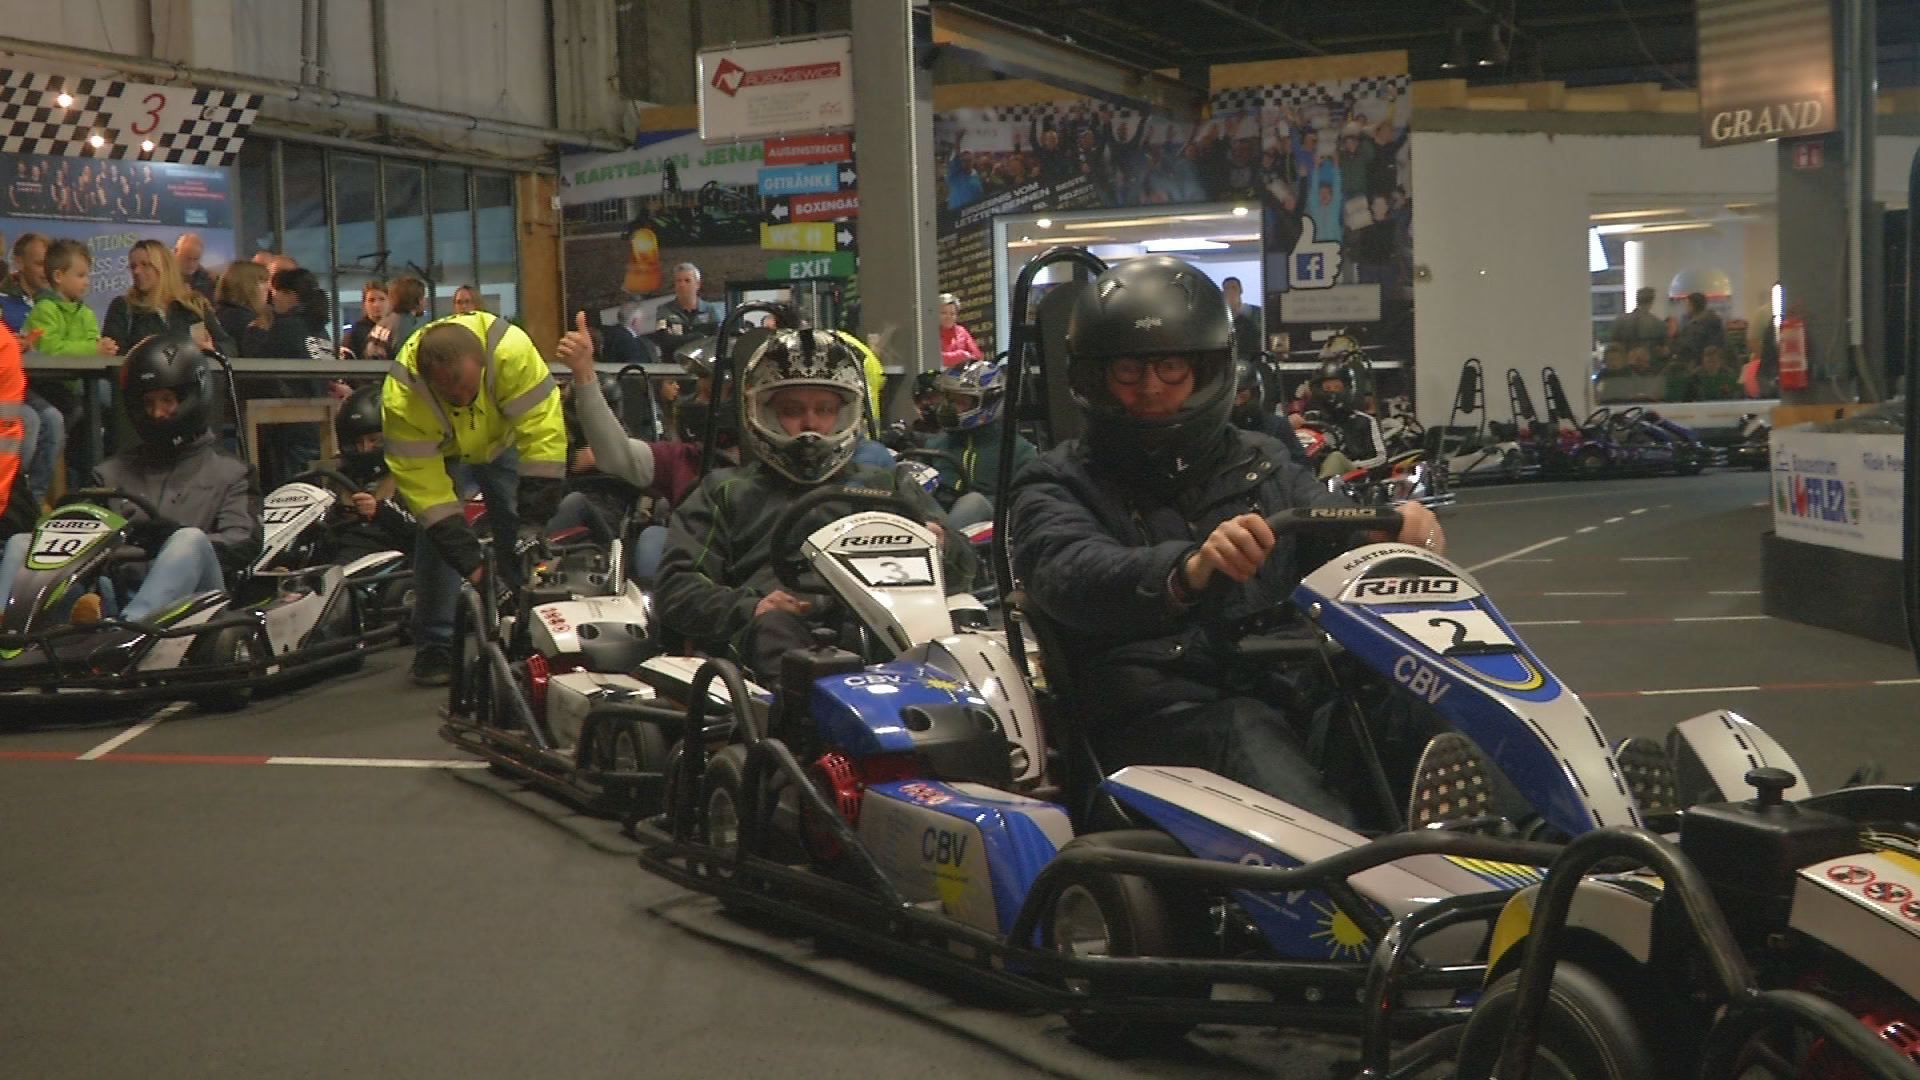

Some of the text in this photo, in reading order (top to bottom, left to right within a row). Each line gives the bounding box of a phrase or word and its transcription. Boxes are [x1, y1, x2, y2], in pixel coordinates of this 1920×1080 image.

[131, 93, 166, 135] 3
[1711, 100, 1822, 140] GRAND
[764, 172, 832, 190] GETRÄNKE
[790, 258, 832, 279] EXIT
[879, 561, 910, 581] 3
[1427, 617, 1489, 655] 2
[843, 674, 900, 687] CBV
[1394, 654, 1451, 704] CBV
[922, 827, 968, 868] CBV
